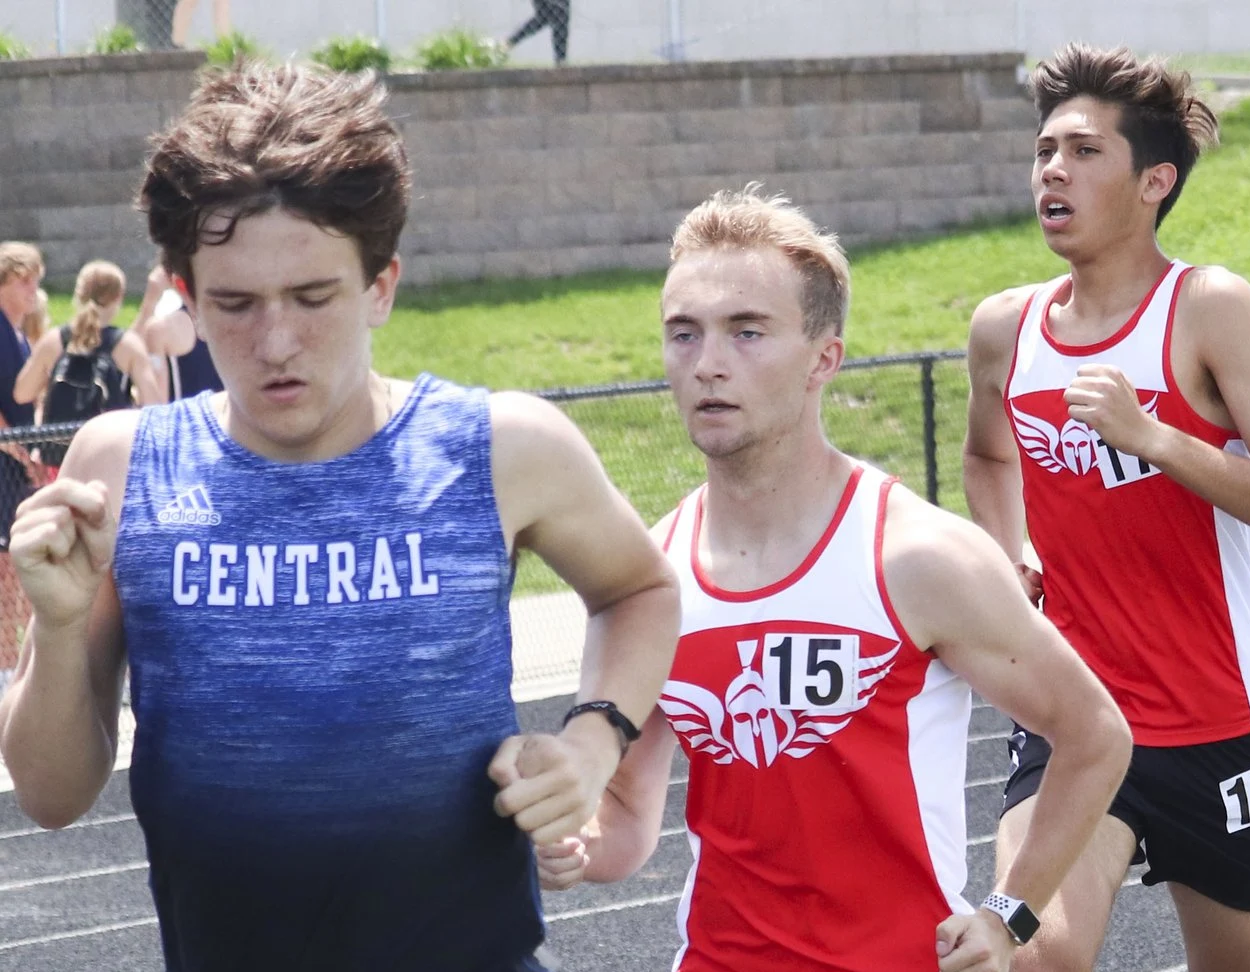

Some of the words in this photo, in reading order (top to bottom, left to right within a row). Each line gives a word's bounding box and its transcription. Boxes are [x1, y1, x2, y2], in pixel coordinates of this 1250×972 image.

[158, 507, 221, 526] adidas
[173, 532, 439, 606] CENTRAL
[769, 636, 844, 706] 15
